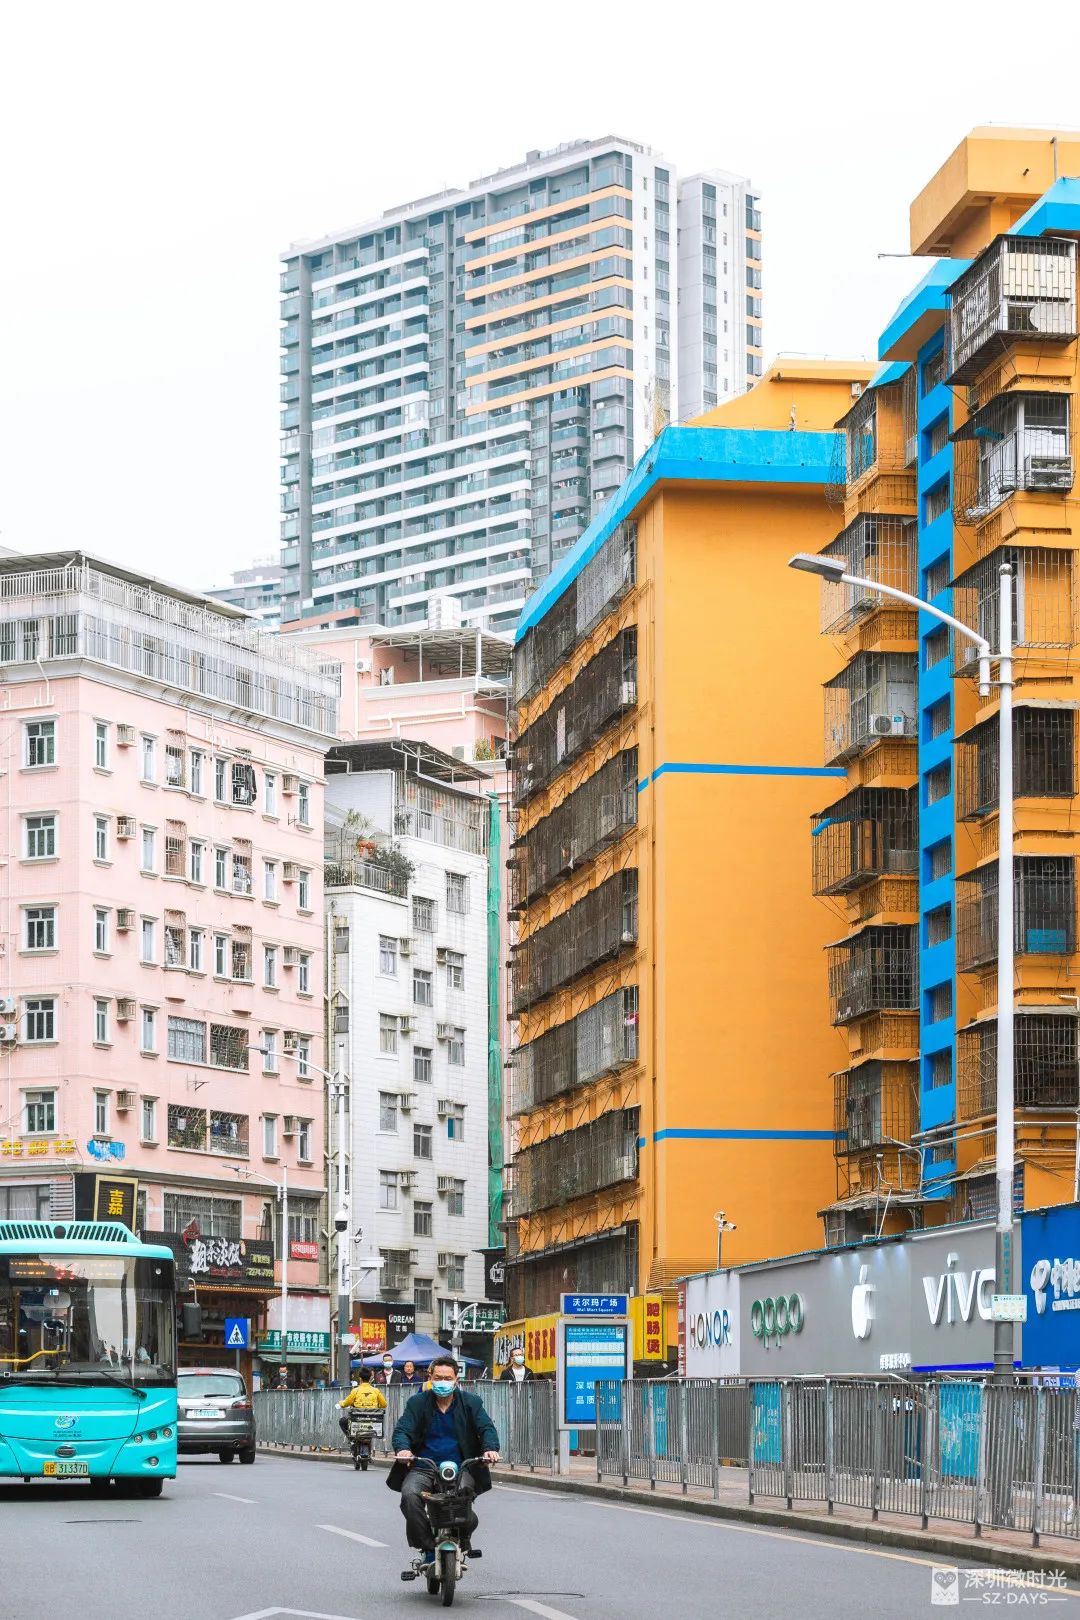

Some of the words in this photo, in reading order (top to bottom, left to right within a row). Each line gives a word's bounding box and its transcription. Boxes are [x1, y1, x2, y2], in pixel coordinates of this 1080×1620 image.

[573, 1298, 618, 1307] 沃尔玛广场
[751, 1292, 804, 1350] oppo
[690, 1309, 730, 1348] HONOR
